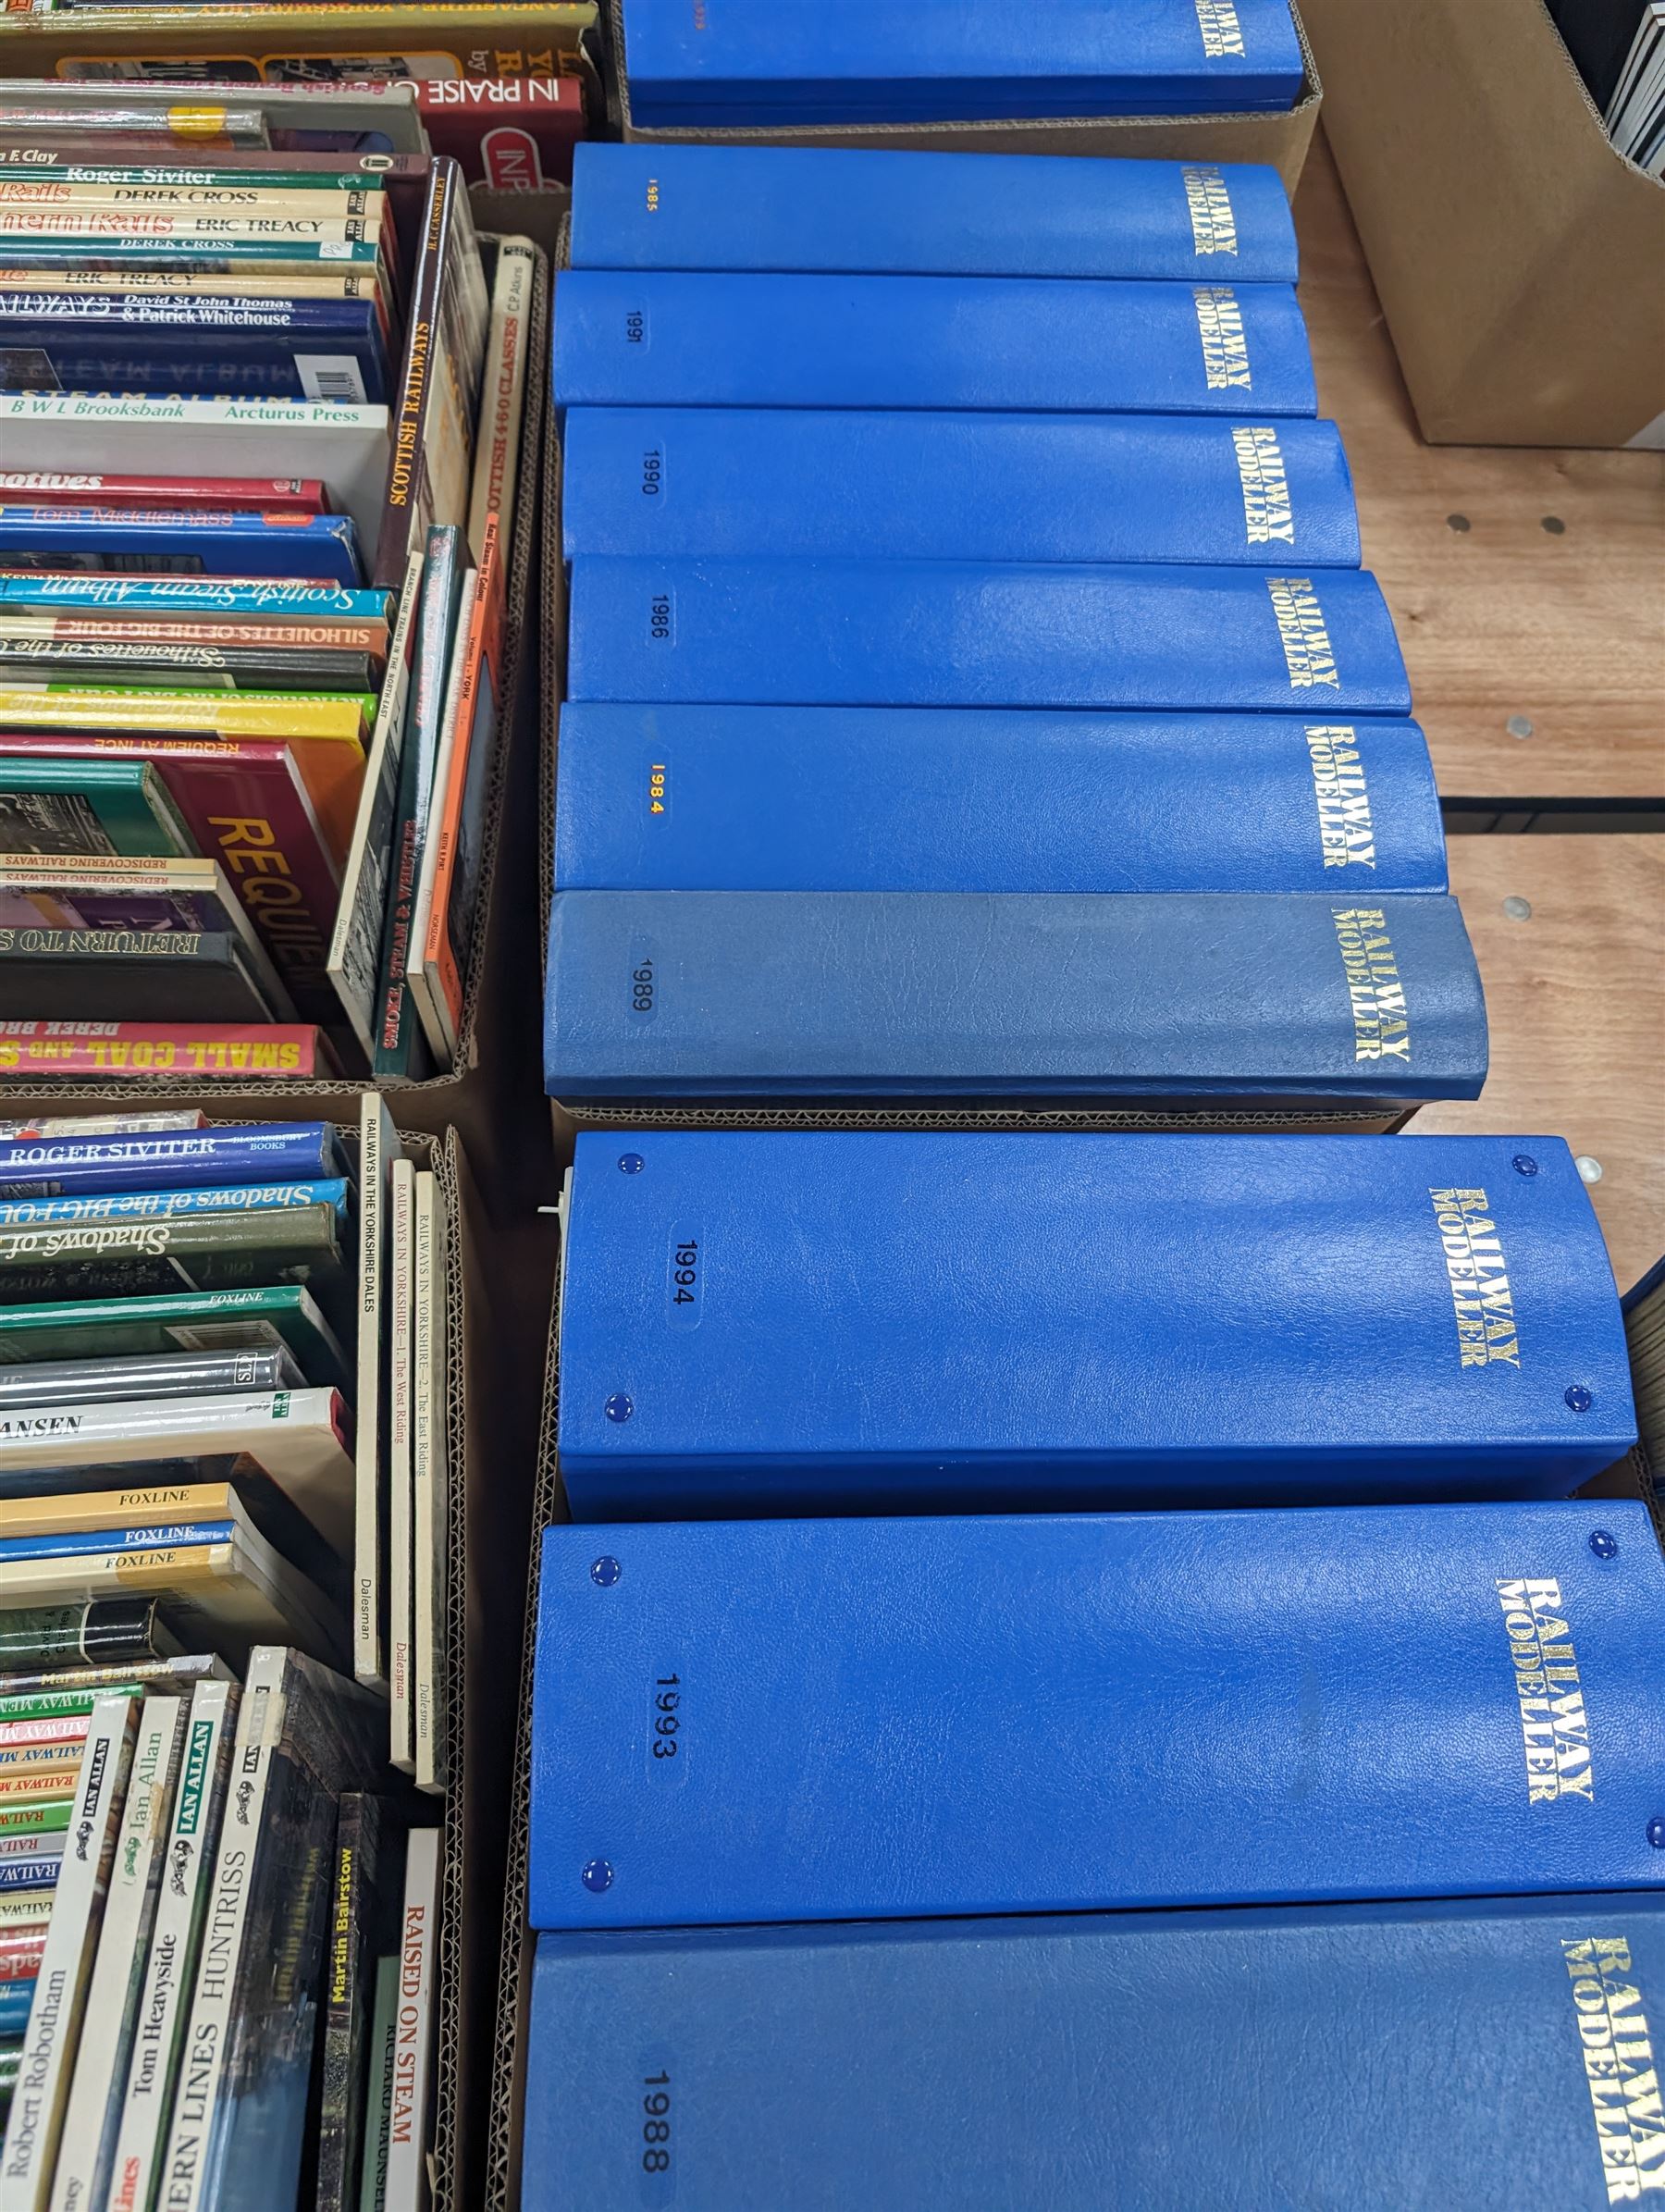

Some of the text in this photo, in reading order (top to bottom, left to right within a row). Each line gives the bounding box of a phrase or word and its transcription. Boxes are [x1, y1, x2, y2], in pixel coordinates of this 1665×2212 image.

[468, 50, 488, 72] by
[428, 80, 520, 103] PRAISE
[529, 79, 559, 102] IN
[22, 150, 58, 166] Clay
[65, 167, 216, 185] Roger Siviter
[113, 189, 184, 204] DEREK
[188, 191, 258, 205] CROSS
[119, 238, 235, 250] DEREK CROSS
[195, 218, 324, 233] ERIC TREACY
[64, 271, 199, 286] ERIC TREACY
[123, 293, 294, 309] David St John Thomas
[122, 307, 292, 327] & Patrick Whitehouse
[1192, 287, 1229, 390] MODELLER
[1212, 288, 1252, 391] RAILWAY
[498, 316, 520, 396] CLASSES
[11, 401, 186, 418] B W L Brooksbank
[224, 405, 360, 423] Arcturus Press
[389, 320, 431, 507] SCOTTISH RAILWAYS
[642, 450, 661, 496] 1990
[1230, 426, 1270, 545] MODELLER
[1252, 427, 1294, 546] RAILWAY
[43, 577, 363, 611] Scottish Steam Album
[651, 594, 670, 639] 1986
[240, 626, 371, 644] SILHOUETTES
[388, 567, 417, 671] BRANCH LINE TRAINS IN THE
[1264, 577, 1315, 689] MODELLER
[1287, 577, 1340, 690] RAILWAY
[15, 638, 53, 659] the
[54, 640, 83, 660] of
[90, 642, 227, 668] Silhouettes
[462, 673, 474, 701] YORK
[94, 738, 240, 755] REQUIEM AT INCE
[650, 764, 666, 815] 1984
[1303, 725, 1349, 870] MODELLER
[1327, 725, 1376, 871] RAILWAY
[5, 855, 167, 871] REDISCOVERING RAILWAYS
[67, 873, 168, 885] REDISCOVERING
[395, 904, 412, 919] &
[429, 913, 439, 950] NORSEMAN
[19, 929, 202, 956] RETURN TO
[332, 918, 348, 958] Dalesman
[389, 921, 409, 980] STEAM
[633, 958, 653, 1012] 1989
[1331, 908, 1383, 1062] MODELLER
[1353, 908, 1412, 1063] RAILWAY
[45, 1021, 121, 1037] DEREK
[29, 1041, 302, 1070] SMALL COAL AND
[9, 1137, 216, 1166] ROGER SIVITER
[249, 1141, 286, 1151] BOOKS
[59, 1185, 314, 1220] Shadows of the BIG
[364, 1118, 377, 1314] RAILWAYS IN THE YORKSHIRE DALES
[5, 1225, 170, 1261] Shadows of
[672, 1240, 699, 1306] 1994
[1427, 1187, 1490, 1369] MODELLER
[1453, 1187, 1523, 1369] RAILWAY
[210, 1291, 265, 1304] FOXLINE
[394, 1183, 407, 1445] RAILWAYS IN The West Riding
[415, 1215, 429, 1477] RAILWAYS IN The East Riding
[118, 1489, 191, 1506] FOXLINE
[124, 1525, 195, 1543] FOXLINE
[105, 1551, 178, 1569] FOXLINE
[361, 1577, 372, 1640] Dalesman
[41, 1671, 94, 1686] Martin
[396, 1641, 407, 1699] Dalesman
[1494, 1576, 1560, 1804] MODELLER
[1523, 1576, 1595, 1804] RAILWAY
[419, 1683, 430, 1739] Dalesman
[651, 1672, 682, 1760] 1993
[14, 1775, 75, 1791] RAILWAY
[85, 1740, 108, 1816] IAN ALLAN
[130, 1732, 162, 1829] Ian Allan
[180, 1724, 210, 1832] IAN ALLAN
[330, 1847, 353, 2004] Martin Bairstow
[182, 1850, 246, 2122] LINES HUNTRISS
[24, 1969, 67, 2092] Robotham
[132, 1934, 178, 2098] Tom Heavyside
[392, 1905, 426, 2144] RAISED ON STEAM
[1560, 1938, 1642, 2206] MODELLER
[7, 2096, 42, 2180] Robert
[642, 2069, 671, 2173] 1988
